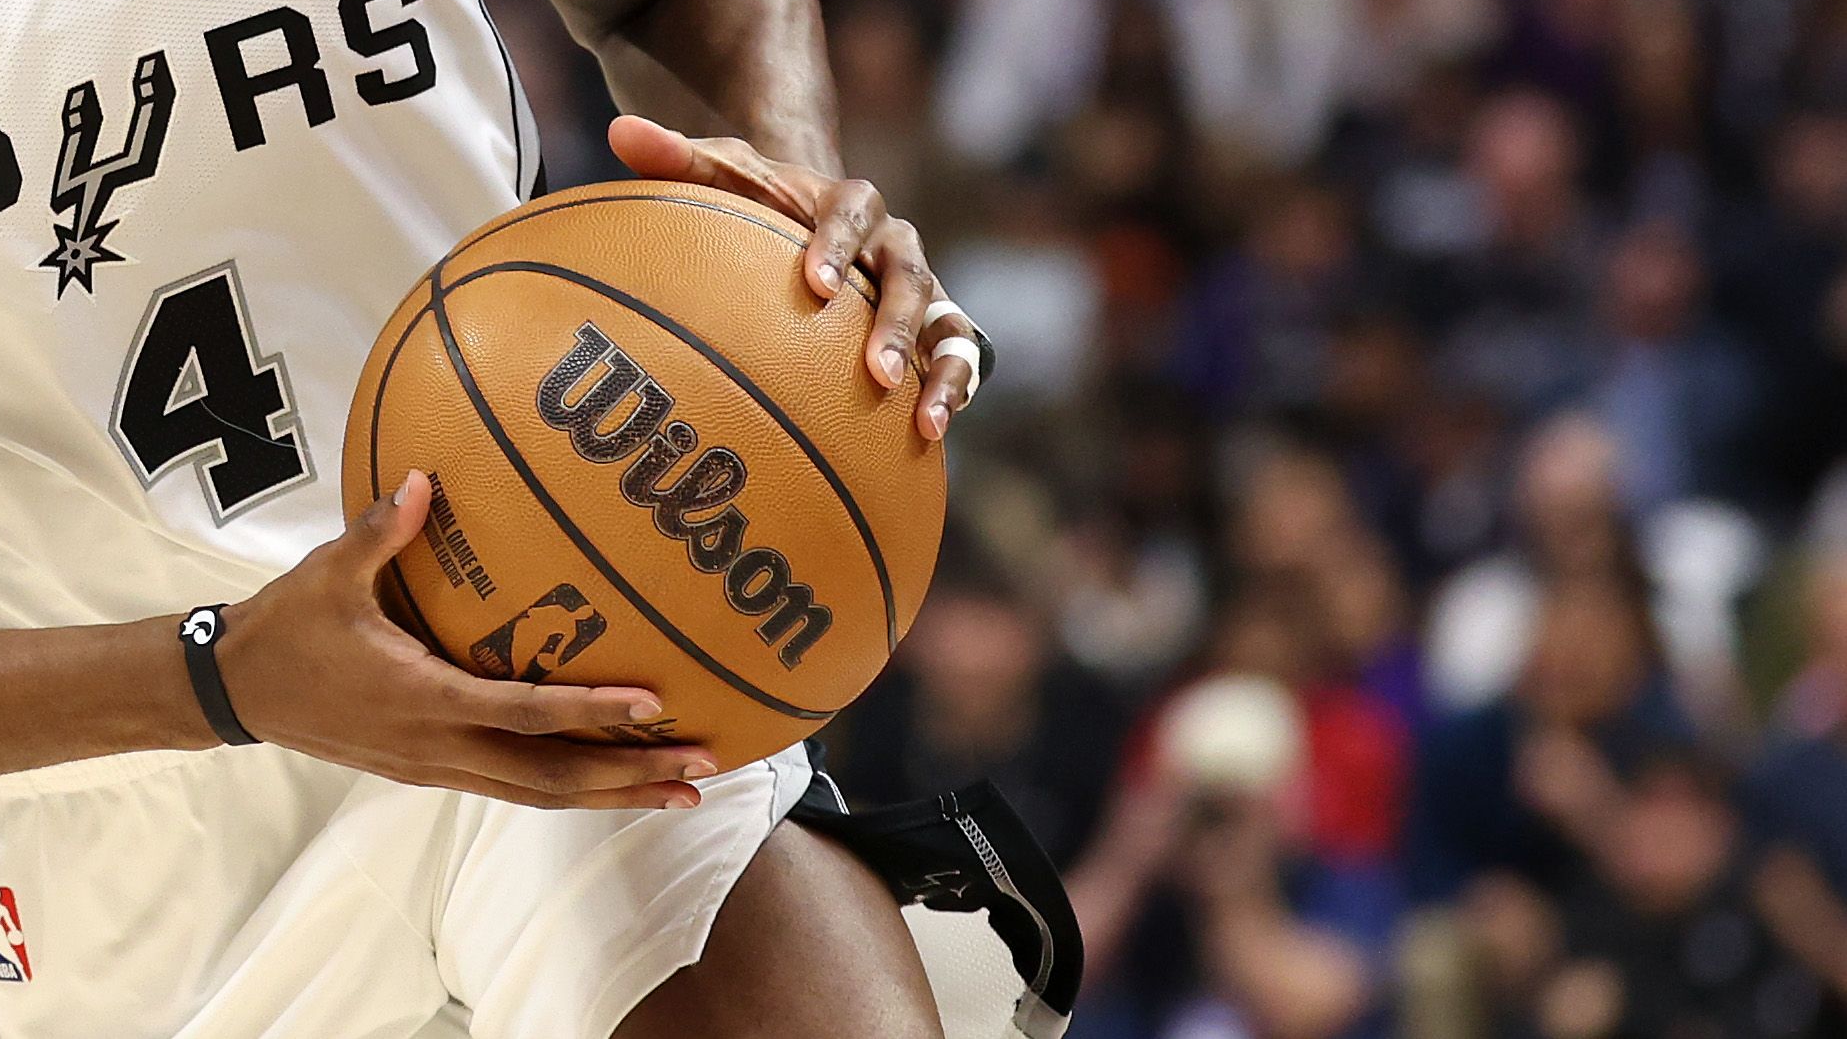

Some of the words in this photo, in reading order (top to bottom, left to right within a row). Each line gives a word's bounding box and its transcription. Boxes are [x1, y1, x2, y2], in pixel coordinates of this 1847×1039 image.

[108, 259, 318, 528] 4
[535, 320, 833, 672] Wilson
[446, 529, 478, 571] GAME
[465, 565, 497, 601] BALL
